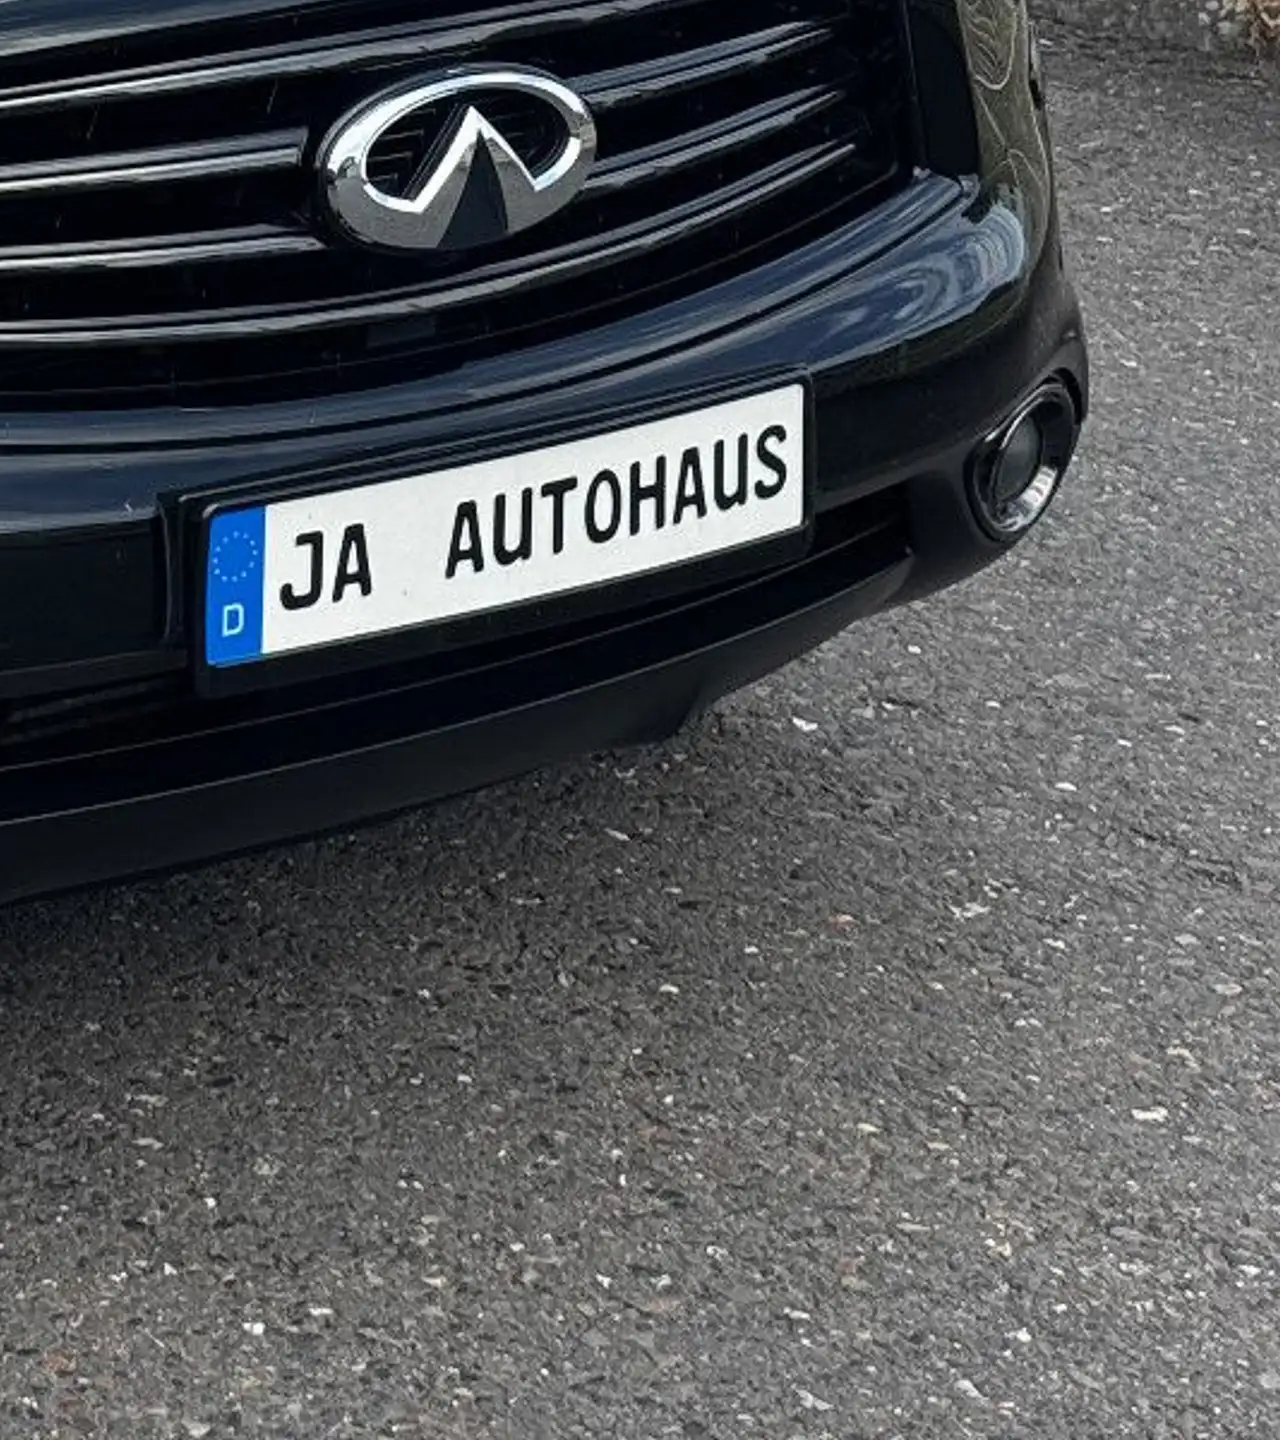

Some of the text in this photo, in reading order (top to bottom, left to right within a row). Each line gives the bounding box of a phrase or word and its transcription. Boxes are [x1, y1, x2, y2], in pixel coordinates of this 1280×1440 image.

[279, 425, 788, 610] JA AUTOHAUS
[221, 603, 245, 637] D
